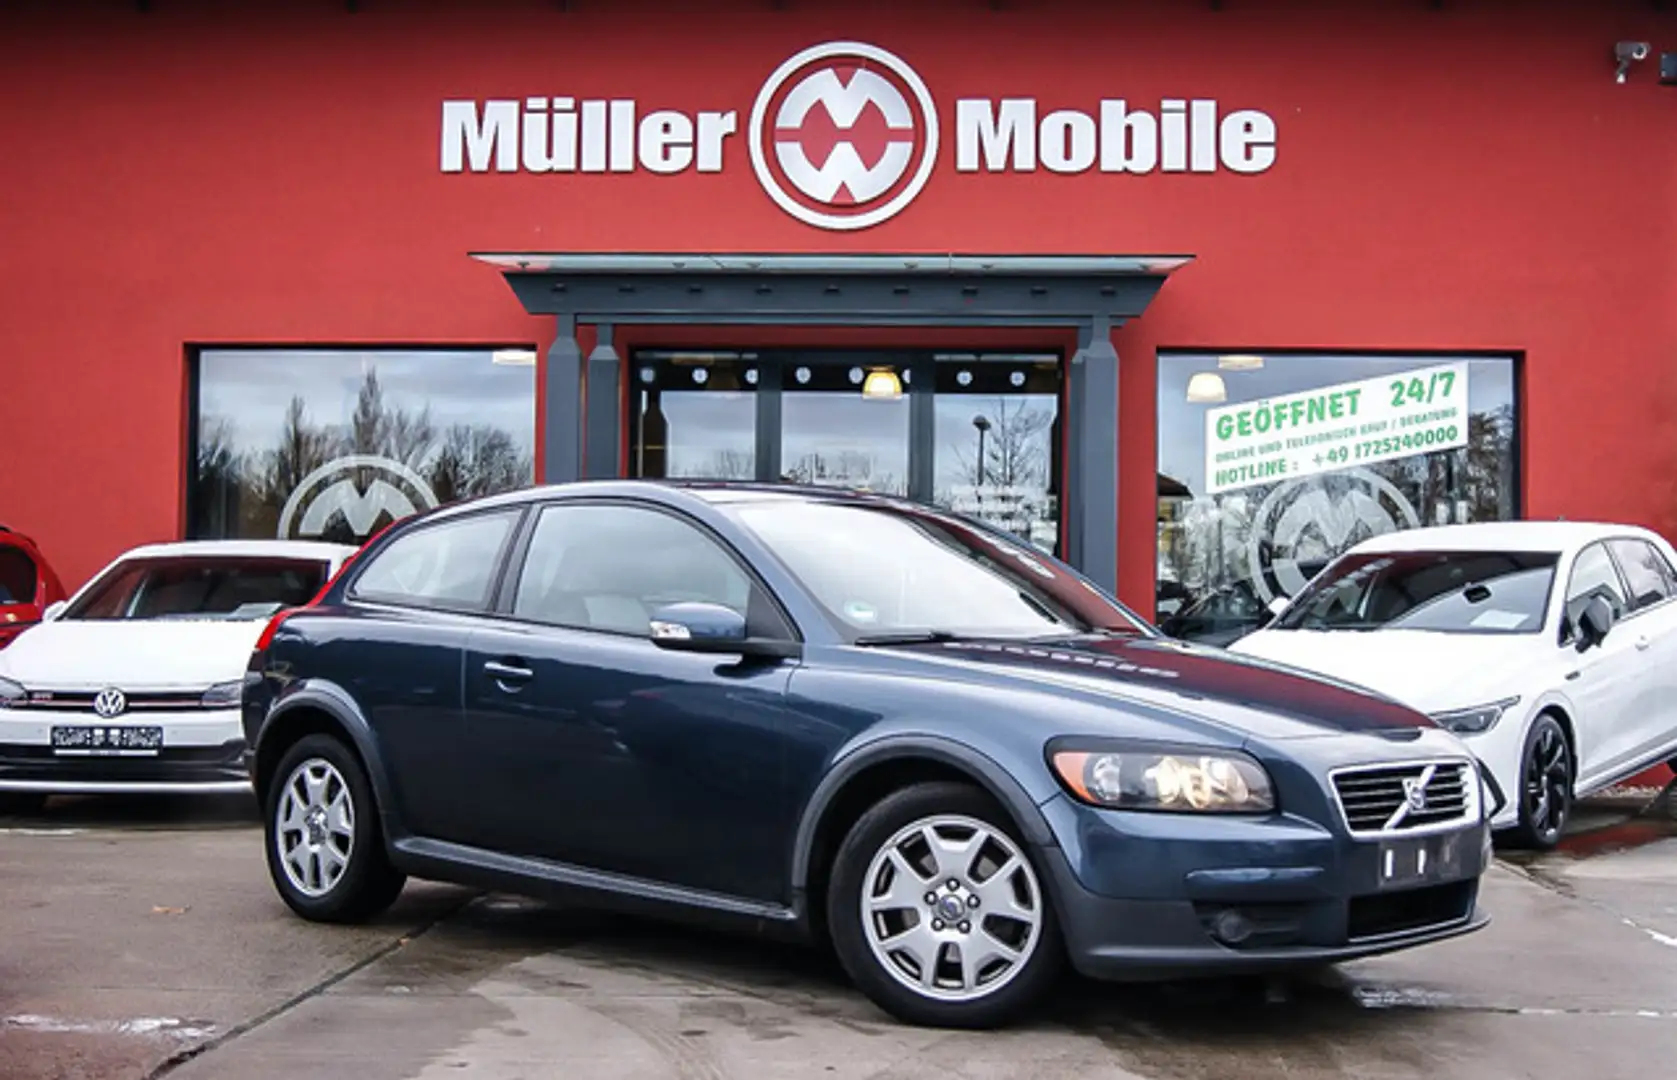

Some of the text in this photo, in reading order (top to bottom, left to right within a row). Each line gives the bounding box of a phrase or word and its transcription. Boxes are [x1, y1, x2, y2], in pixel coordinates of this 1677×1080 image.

[440, 97, 1277, 173] Müller Mobile
[1216, 371, 1456, 441] GEÖFFNET 24/7
[1215, 457, 1288, 487] HOTLINE
[1312, 446, 1349, 467] +49
